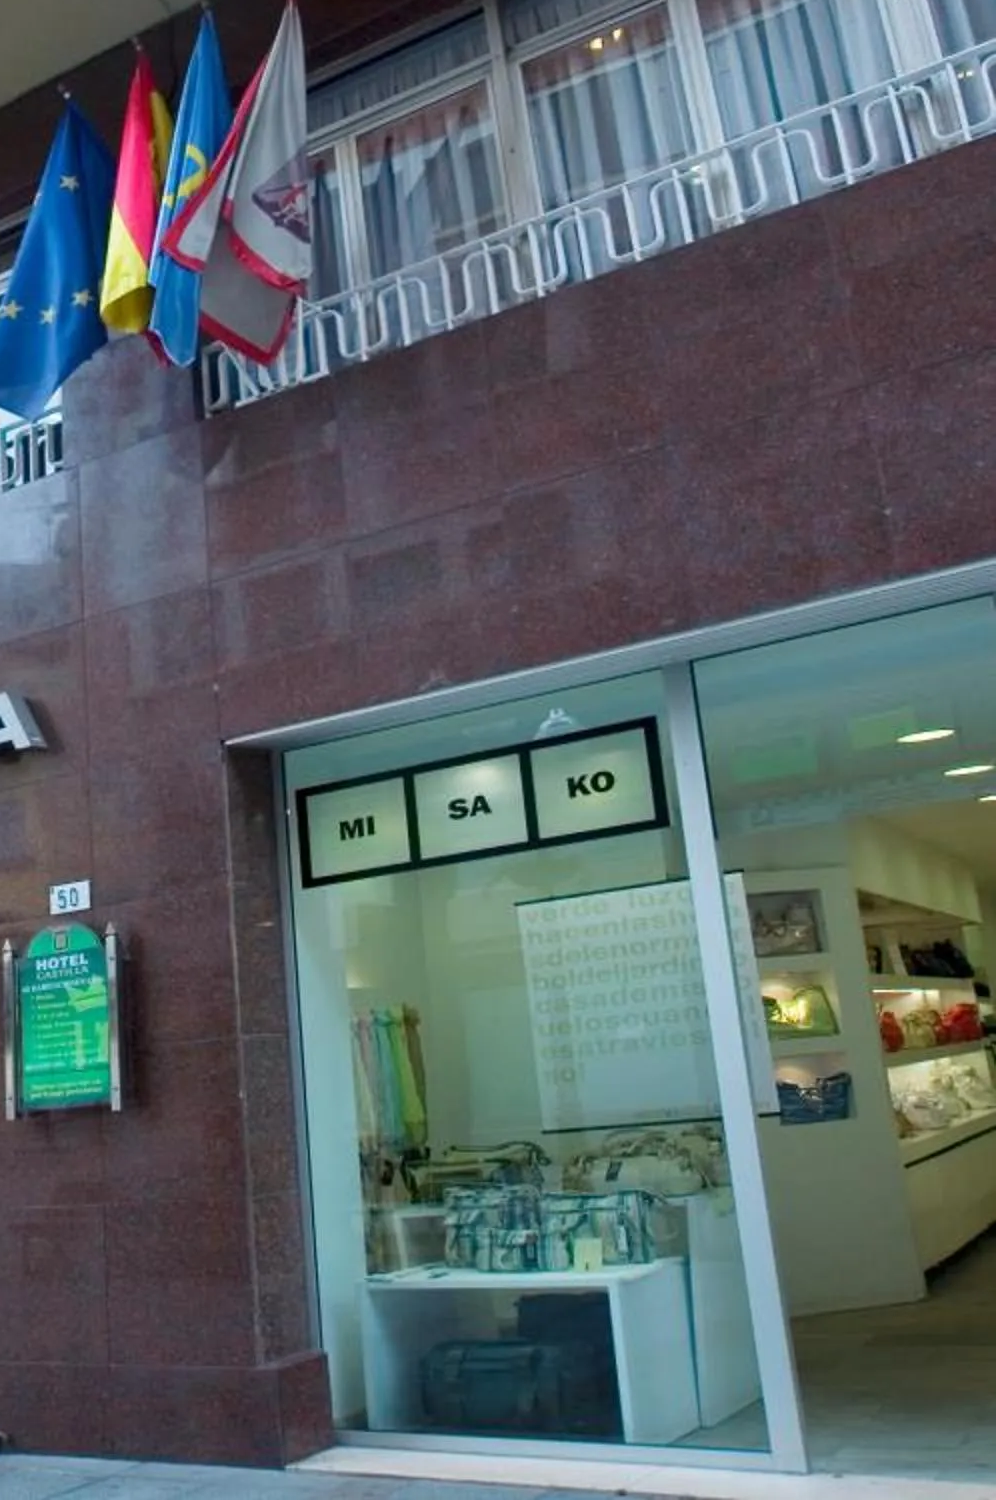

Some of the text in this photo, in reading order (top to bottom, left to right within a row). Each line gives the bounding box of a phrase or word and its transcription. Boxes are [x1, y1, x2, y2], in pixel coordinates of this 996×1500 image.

[338, 770, 616, 841] MI SA KO
[56, 886, 80, 910] 50
[35, 953, 89, 971] HOTEL
